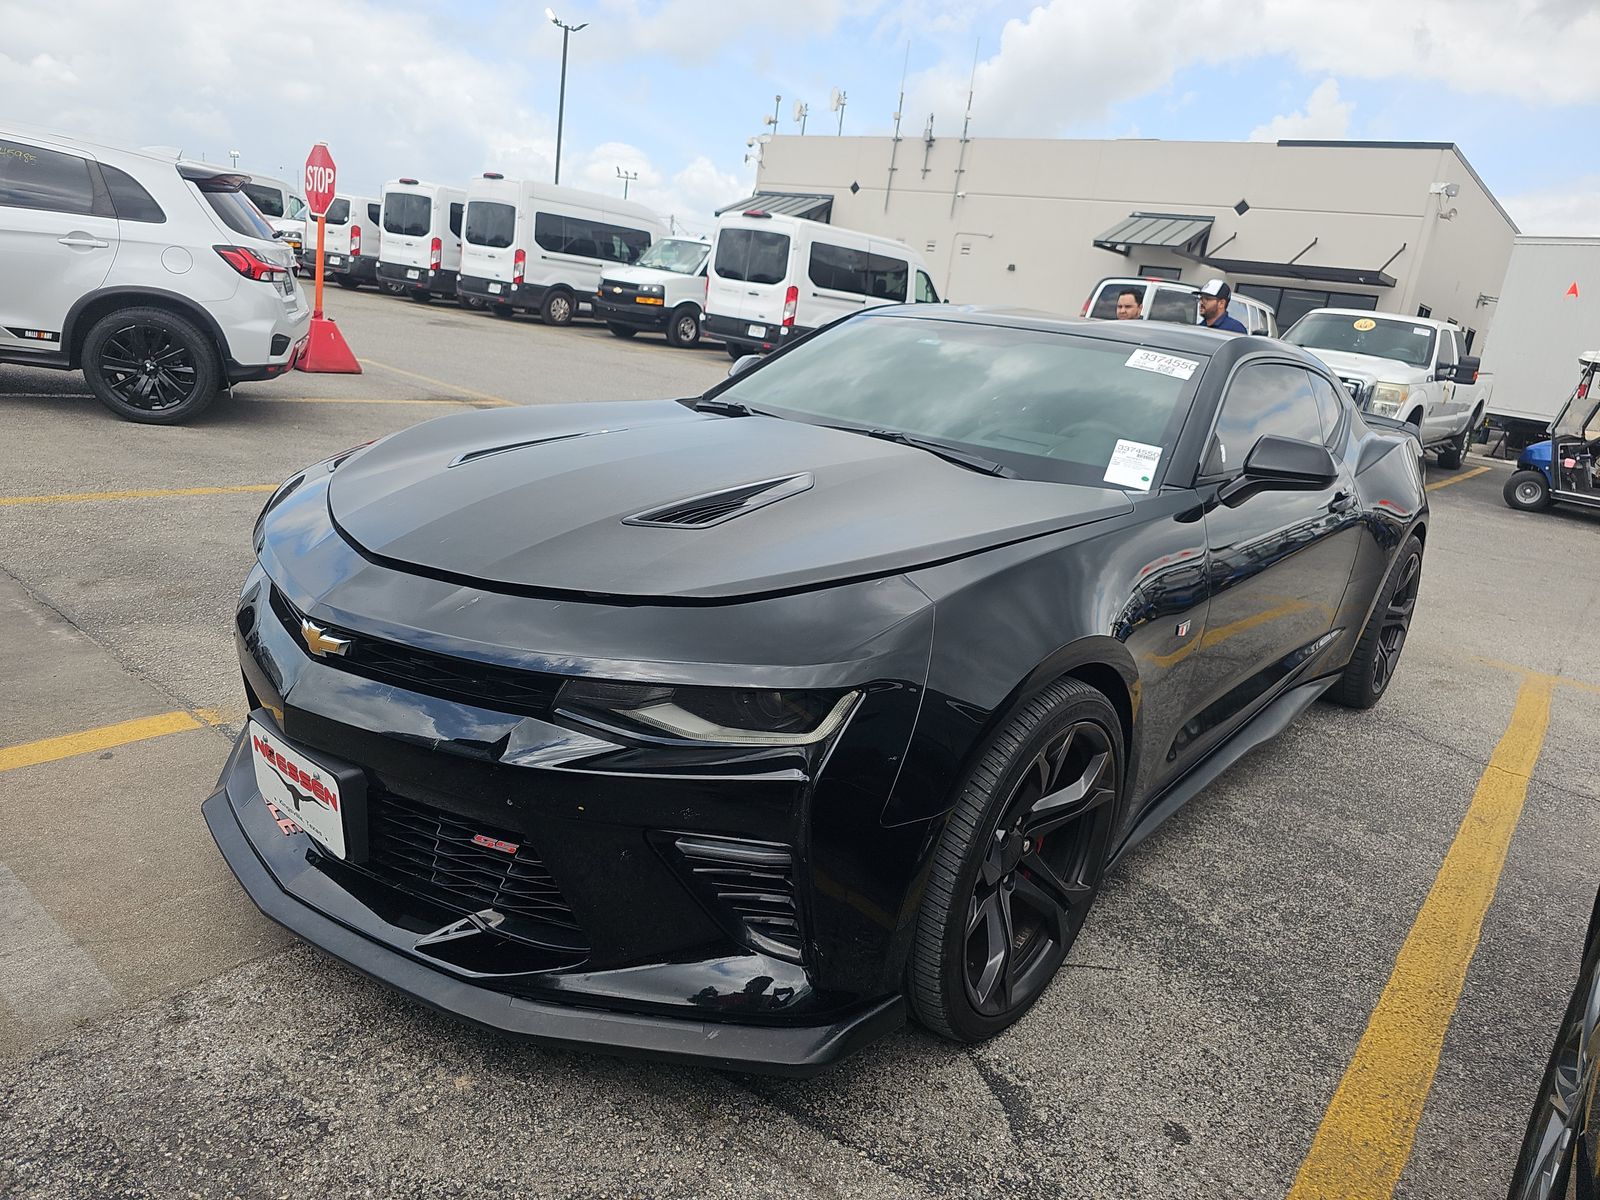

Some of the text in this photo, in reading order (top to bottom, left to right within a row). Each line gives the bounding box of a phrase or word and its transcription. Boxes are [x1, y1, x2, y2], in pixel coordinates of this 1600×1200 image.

[306, 165, 335, 194] STOP
[253, 734, 339, 812] NEESSEN
[471, 834, 520, 854] SS
